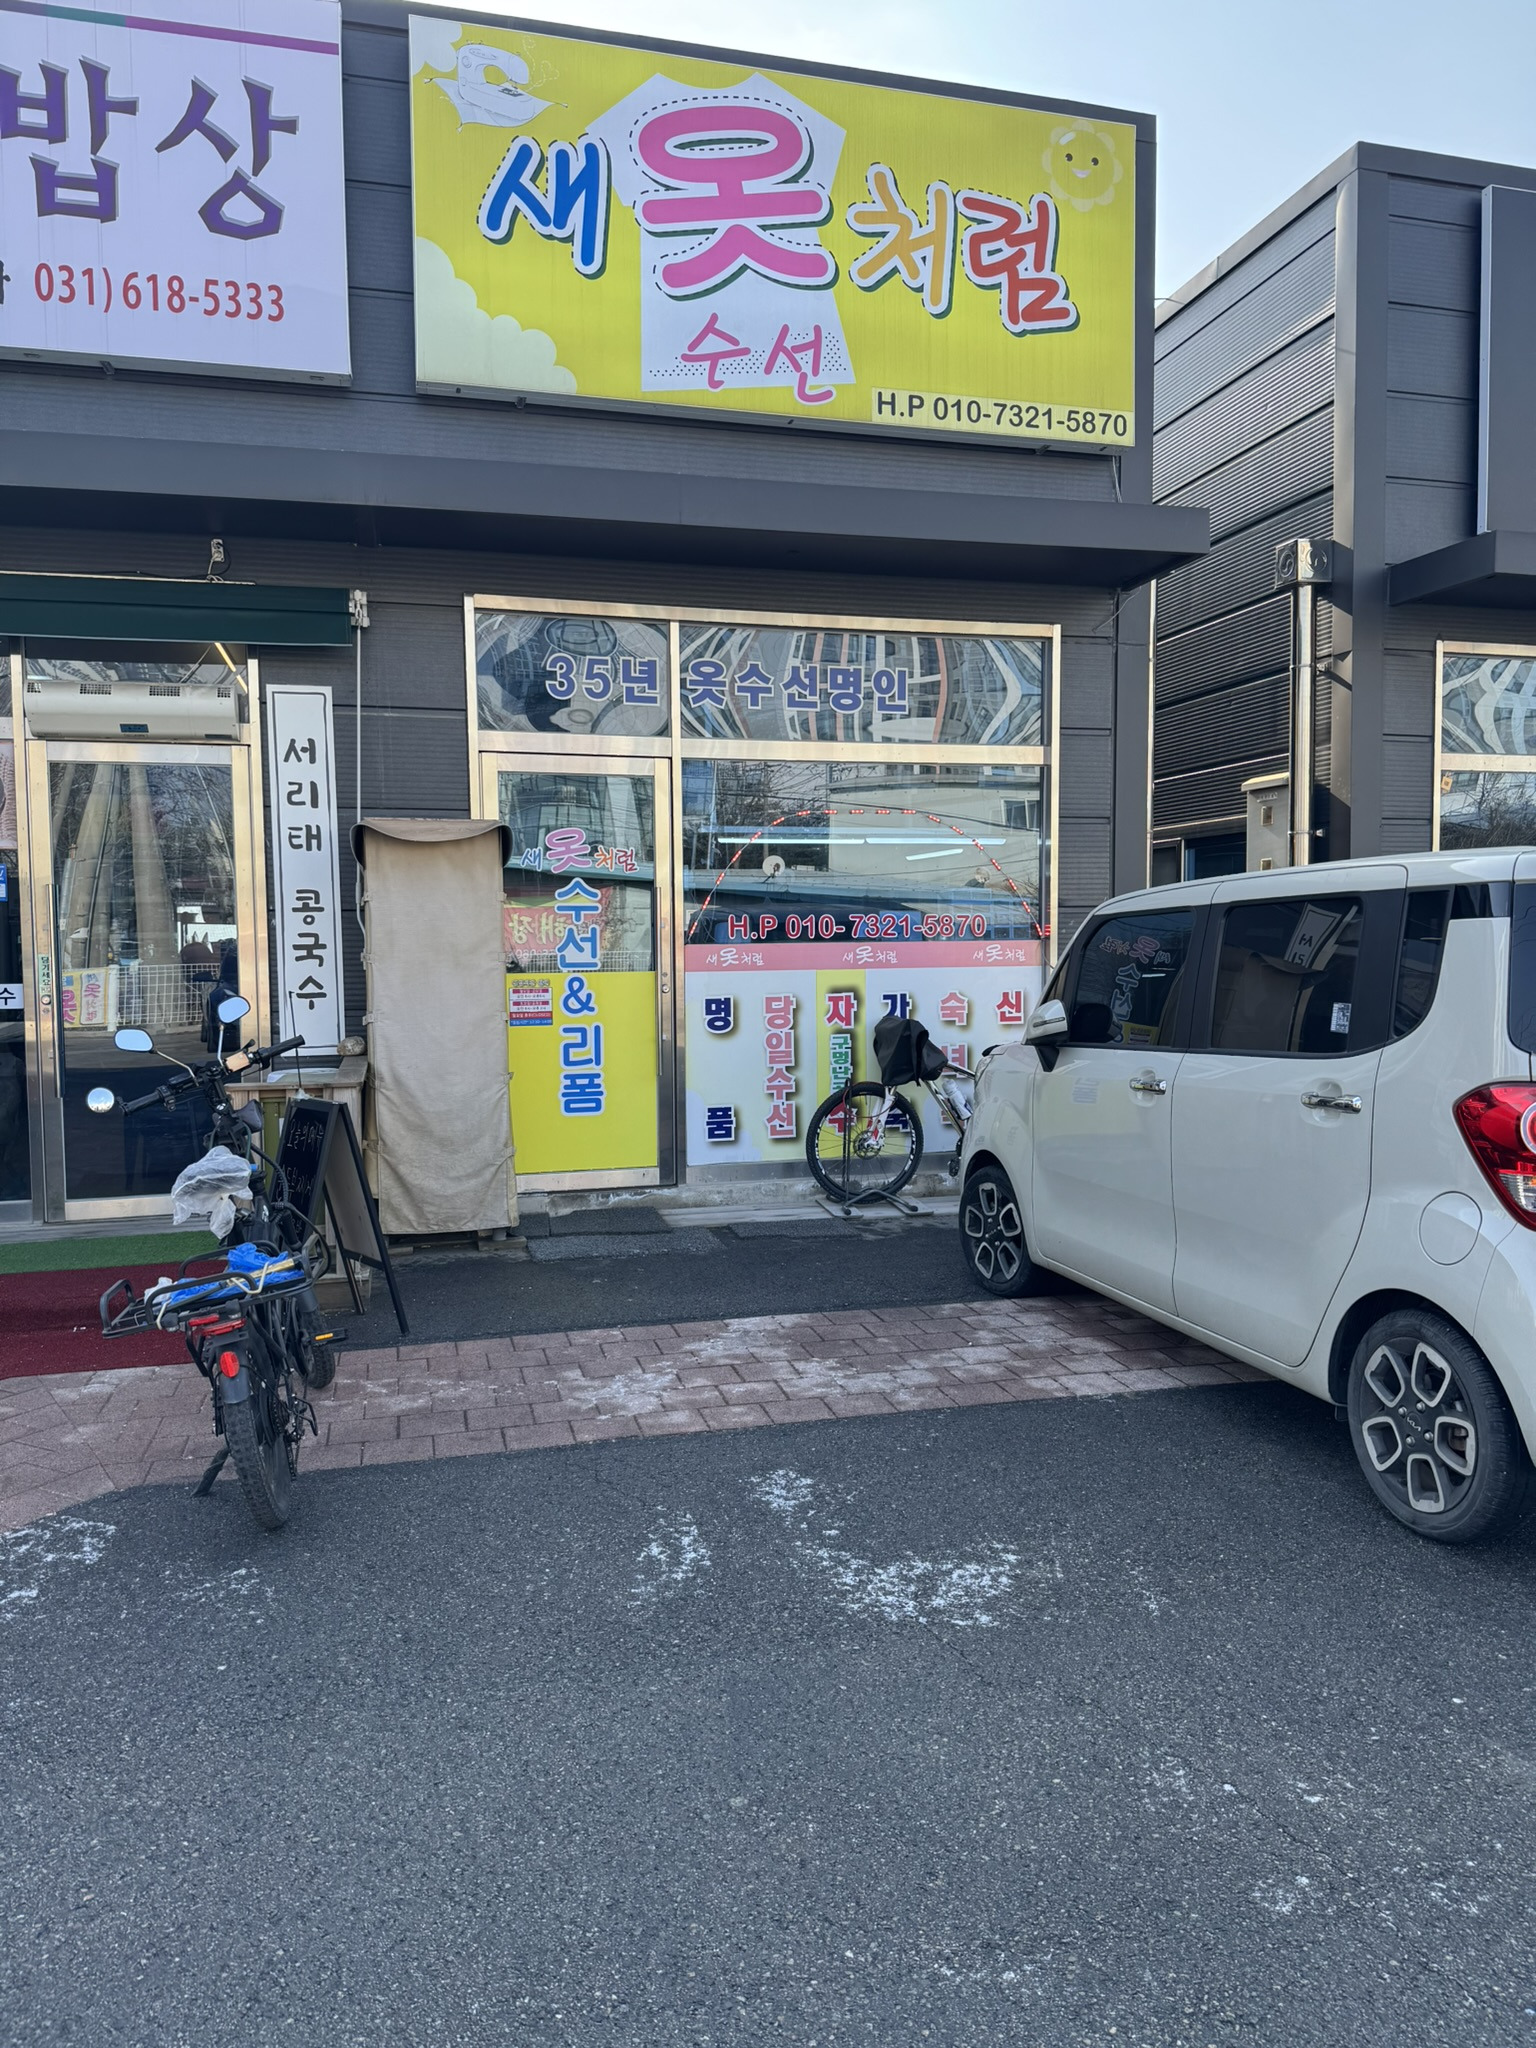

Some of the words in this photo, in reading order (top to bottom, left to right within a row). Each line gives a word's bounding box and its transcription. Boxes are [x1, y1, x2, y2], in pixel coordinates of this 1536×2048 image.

[0, 55, 299, 240] 밥상
[681, 312, 834, 403] 수선
[877, 391, 924, 418] H.P
[933, 397, 1127, 437] 010-7321-5870
[545, 653, 660, 706] 35년
[283, 737, 323, 852] 서리태
[291, 888, 328, 1011] 콩국수
[728, 914, 778, 939] H.P
[785, 913, 987, 938] 010-7321-5870
[762, 993, 797, 1139] 당일수선
